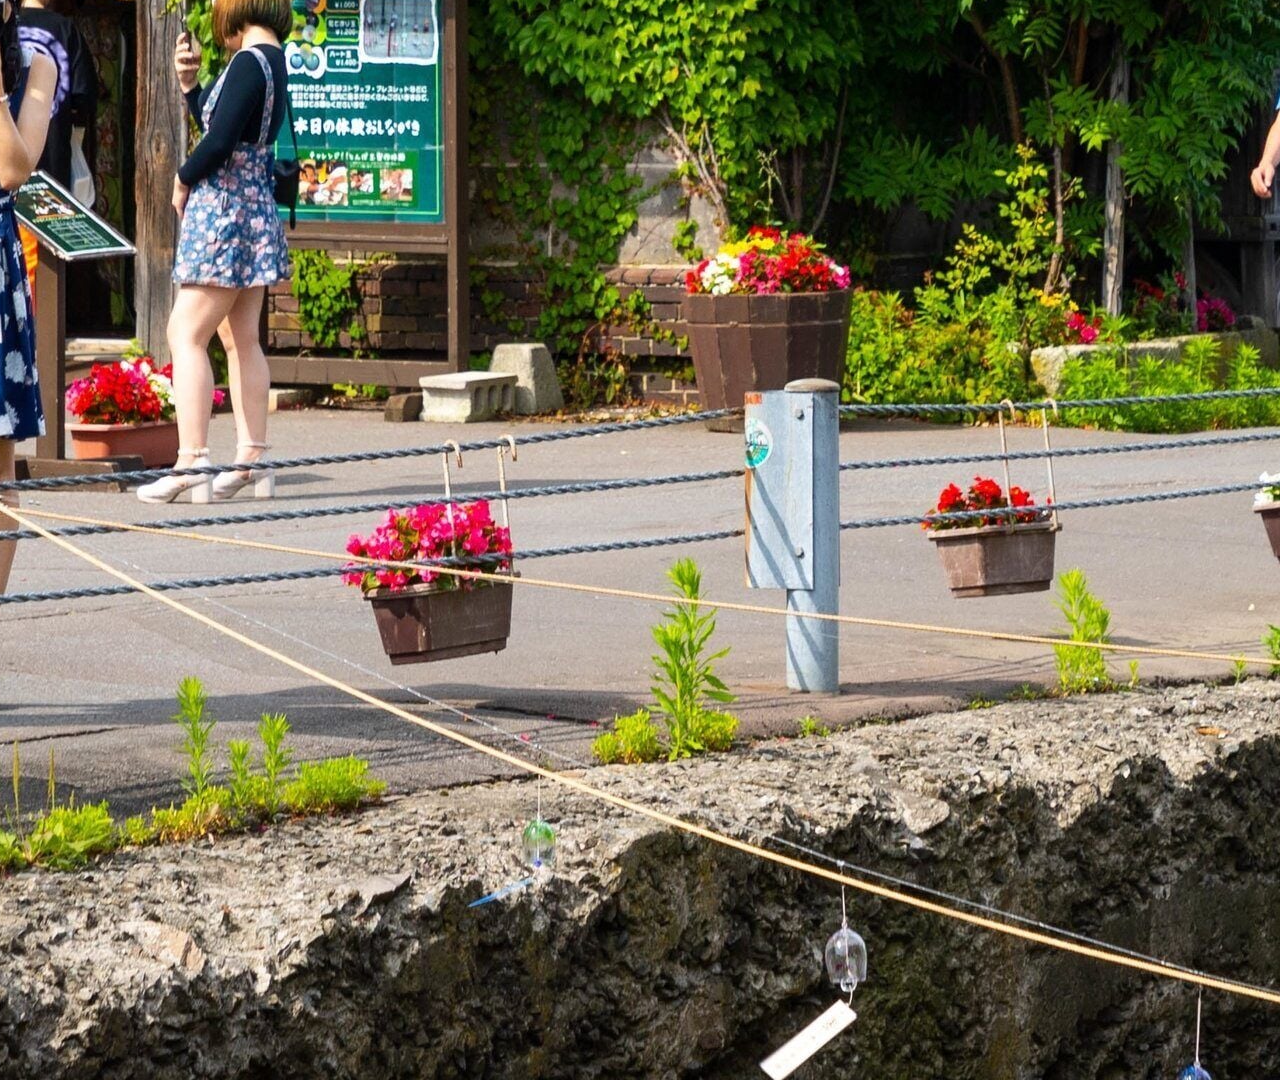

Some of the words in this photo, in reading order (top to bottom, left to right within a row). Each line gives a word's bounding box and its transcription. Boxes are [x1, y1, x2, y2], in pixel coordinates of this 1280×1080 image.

[293, 116, 421, 136] 本日の体験おしながき
